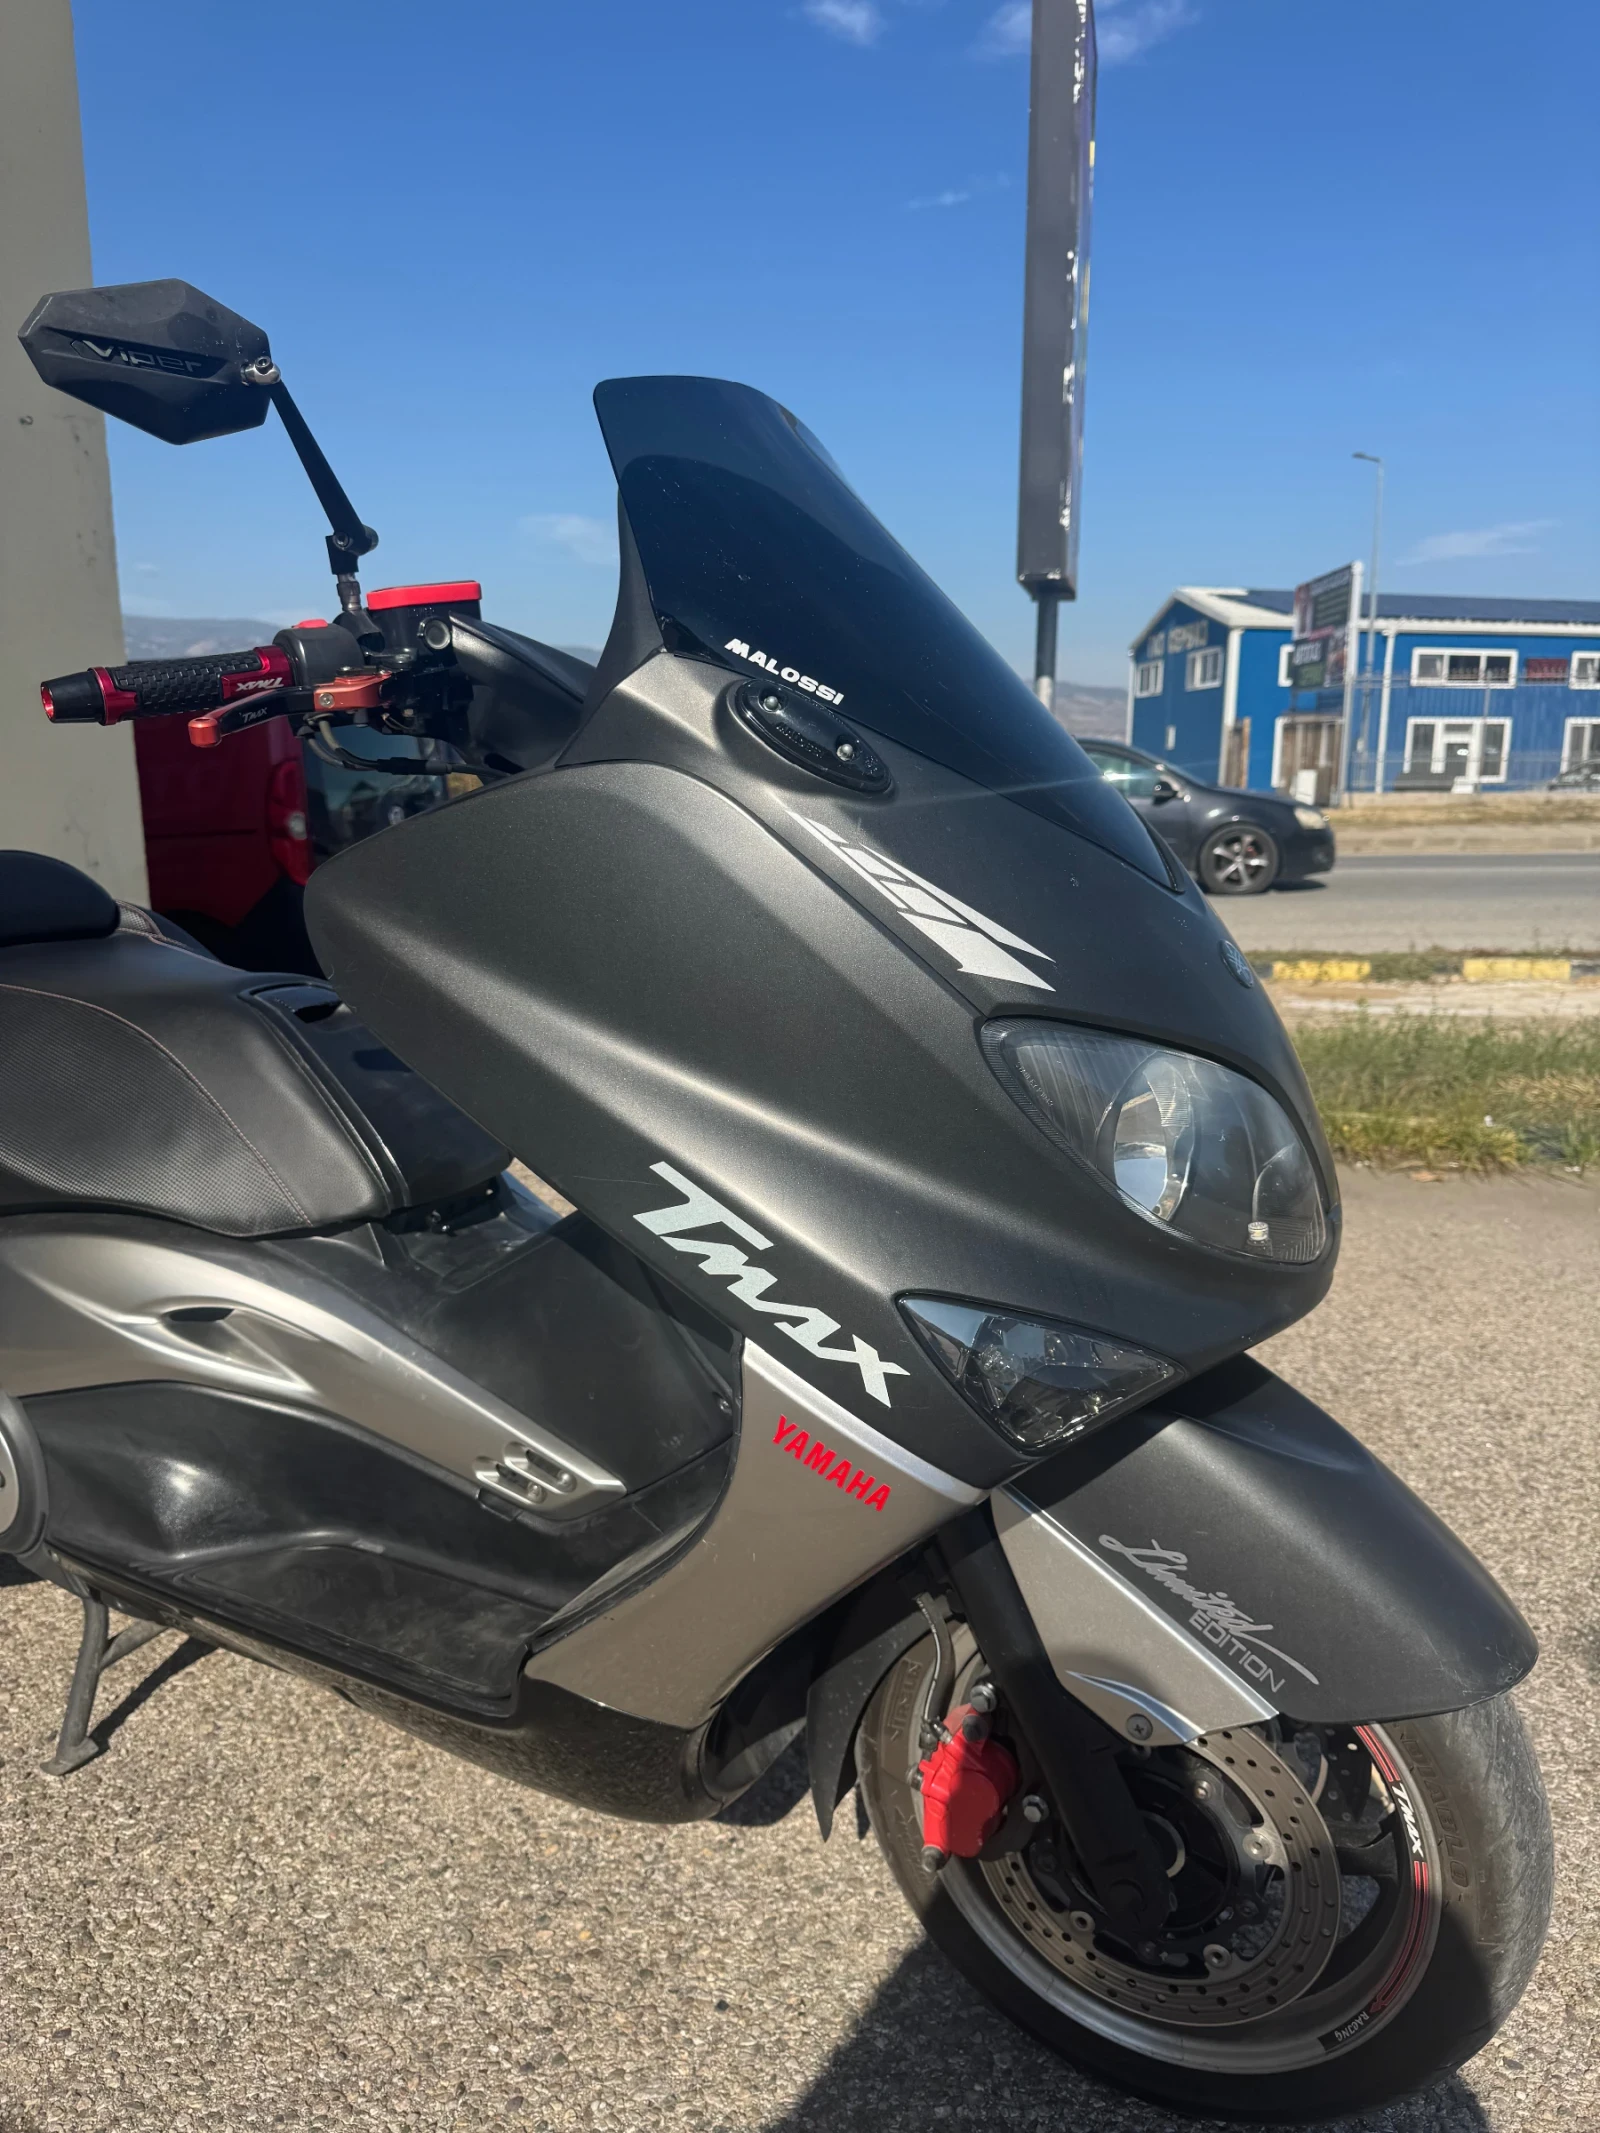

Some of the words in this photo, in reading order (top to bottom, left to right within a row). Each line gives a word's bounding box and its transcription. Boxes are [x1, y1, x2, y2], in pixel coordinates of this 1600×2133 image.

[236, 677, 284, 692] TMAX
[724, 638, 844, 706] MALOSSI
[633, 1161, 911, 1408] TMAX
[772, 1414, 892, 1512] YAMAHA
[1099, 1534, 1319, 1687] Limited
[1189, 1610, 1286, 1693] EDITION
[1392, 1783, 1424, 1858] TMAX
[1403, 1739, 1469, 1888] DIABLO
[1334, 2011, 1370, 2042] RACING
